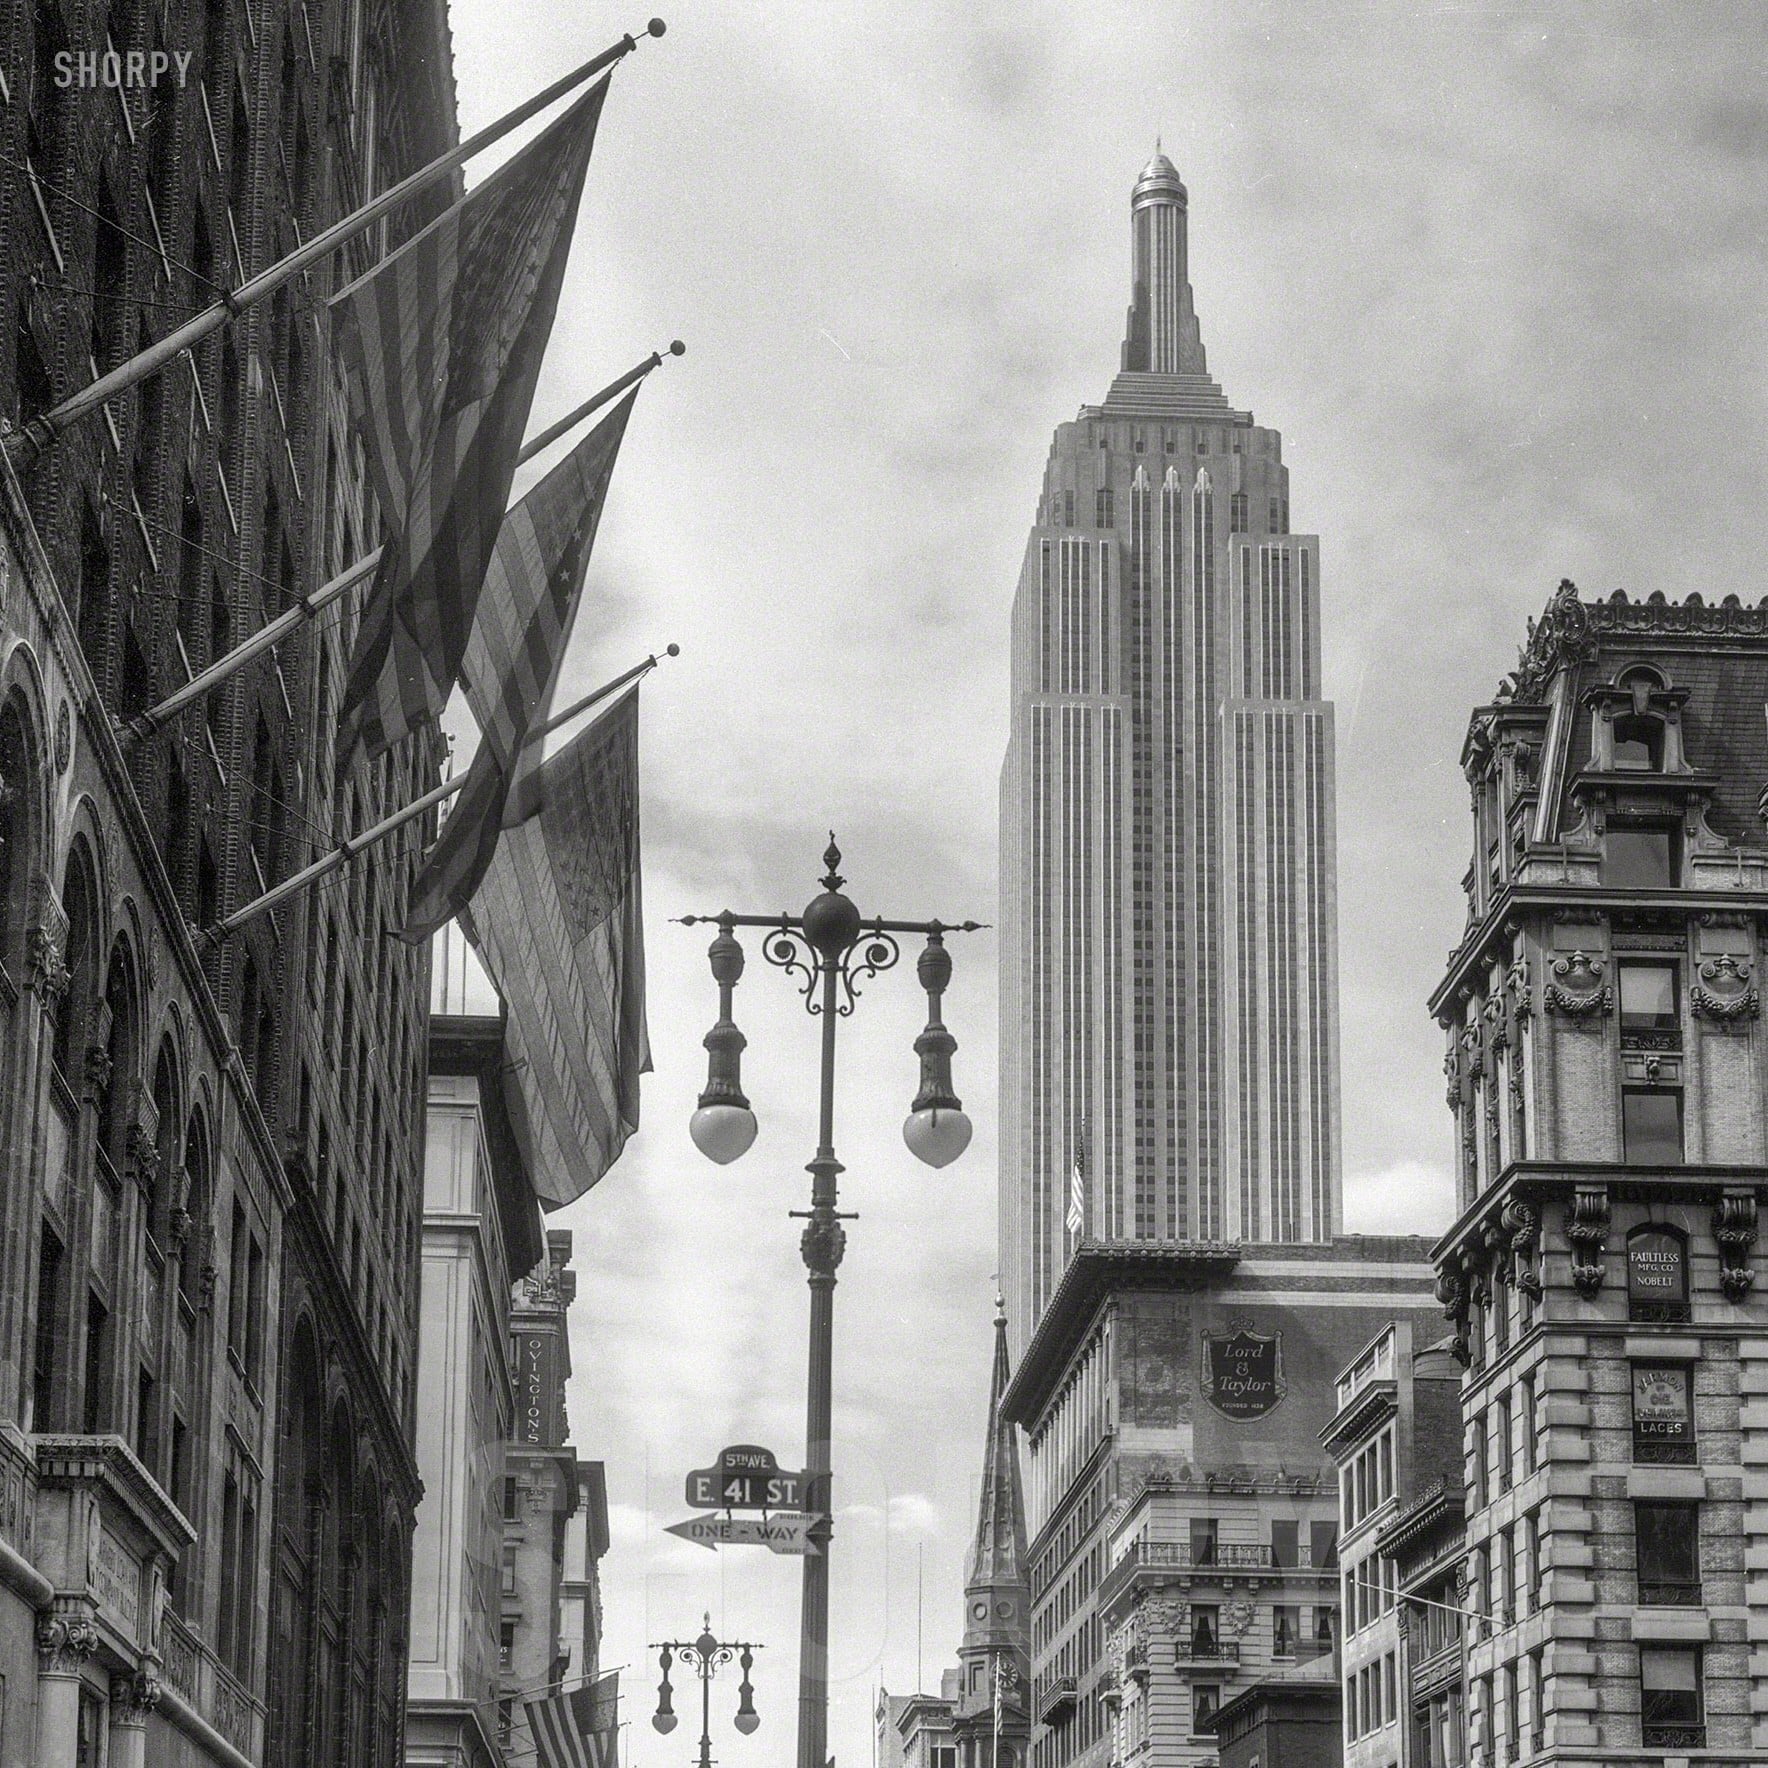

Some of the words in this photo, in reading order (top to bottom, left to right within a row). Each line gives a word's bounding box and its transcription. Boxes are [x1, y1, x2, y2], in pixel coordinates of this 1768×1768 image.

[1631, 1251, 1679, 1263] FAULTLESS
[1637, 1277, 1674, 1286] NOBELT
[1224, 1344, 1264, 1358] Lord
[1235, 1361, 1249, 1376] &
[1220, 1375, 1271, 1397] Taylor
[1641, 1422, 1682, 1433] LACES
[696, 1477, 715, 1502] E.
[723, 1477, 750, 1503] 41
[767, 1478, 799, 1504] ST.
